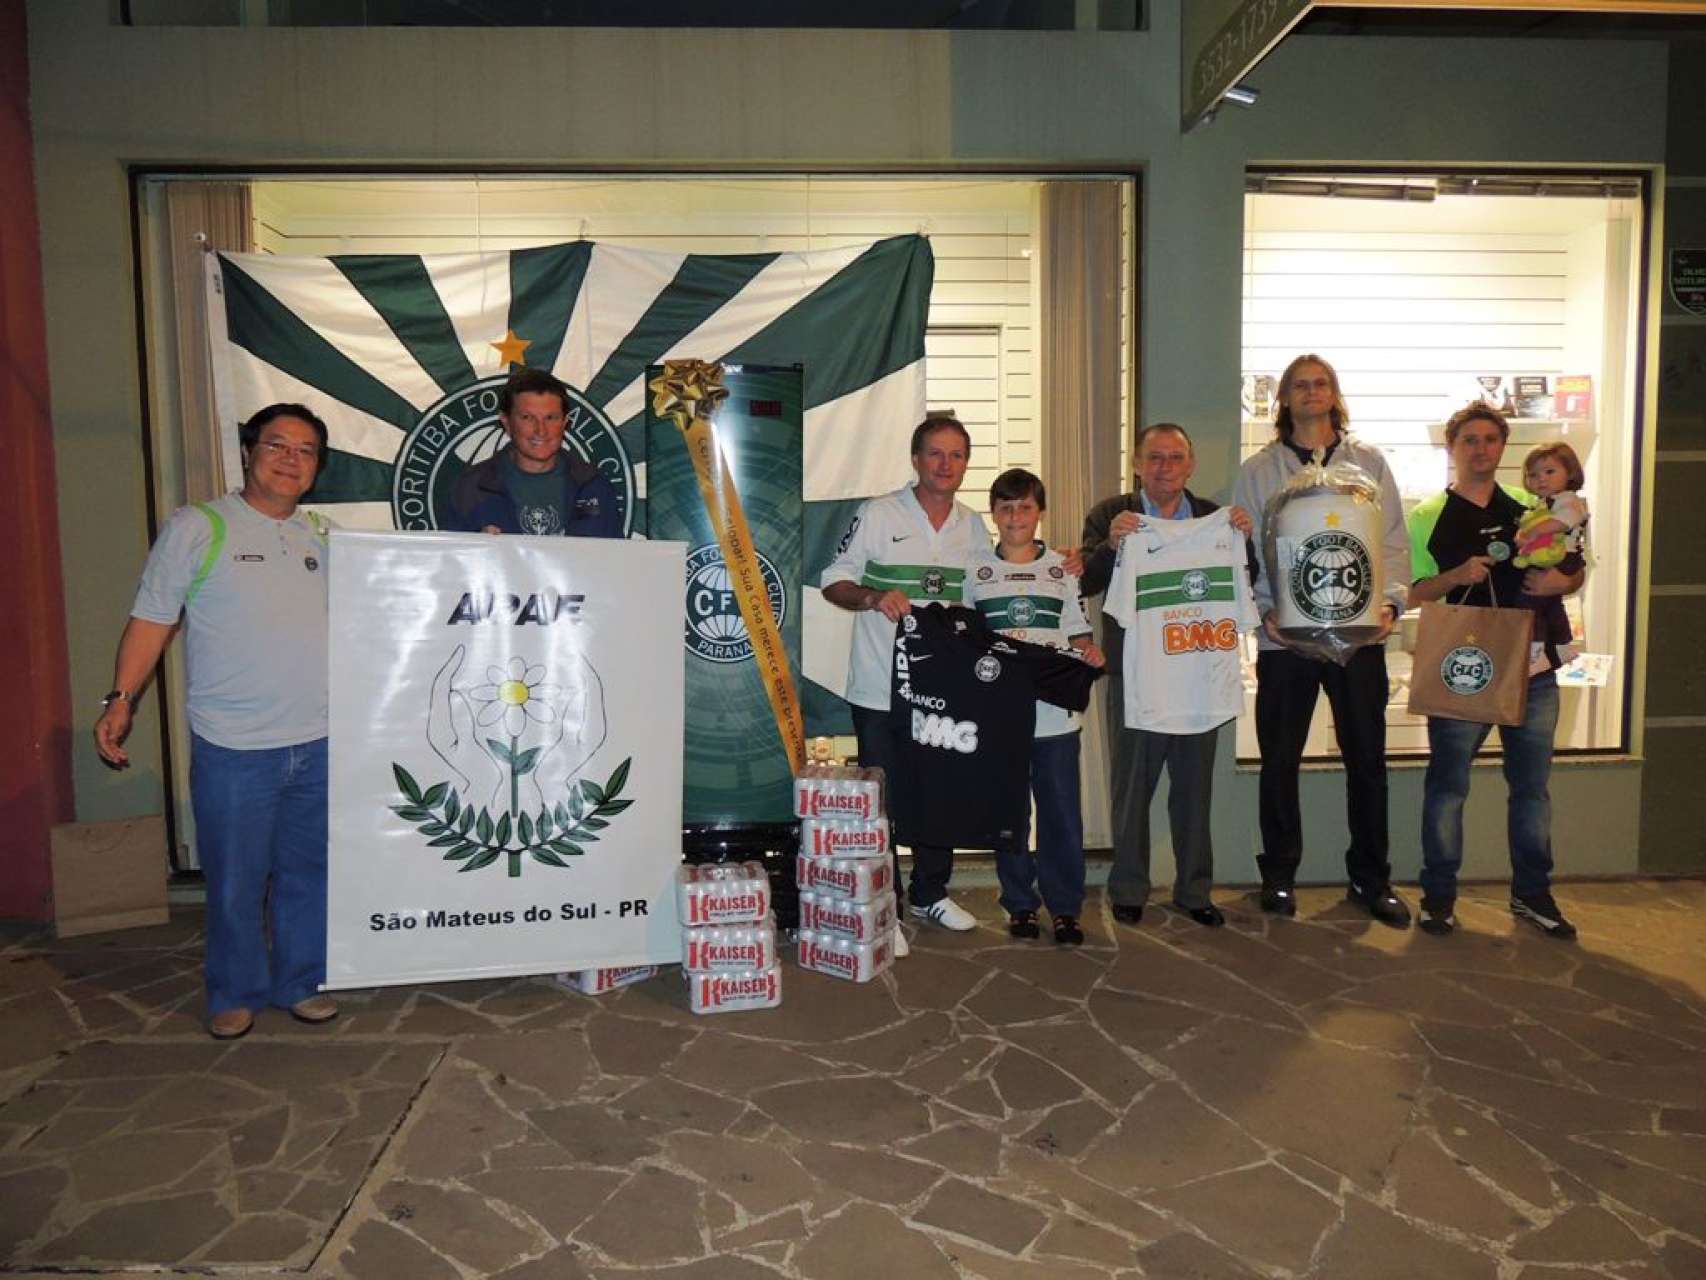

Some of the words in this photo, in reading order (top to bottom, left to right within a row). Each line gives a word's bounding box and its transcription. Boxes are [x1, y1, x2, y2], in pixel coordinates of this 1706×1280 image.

[462, 389, 499, 419] FO
[565, 406, 604, 453] ALL
[1163, 618, 1239, 655] BMG
[819, 794, 863, 809] KAISER
[832, 831, 877, 846] KAISER
[814, 866, 851, 886] KAISER
[709, 894, 756, 911] KAISER
[369, 912, 417, 931] São
[426, 908, 516, 928] Mateus
[523, 905, 552, 923] do
[560, 902, 597, 920] Sul
[618, 899, 649, 917] PR
[709, 945, 756, 960] KAISER
[720, 977, 768, 996] KAISER
